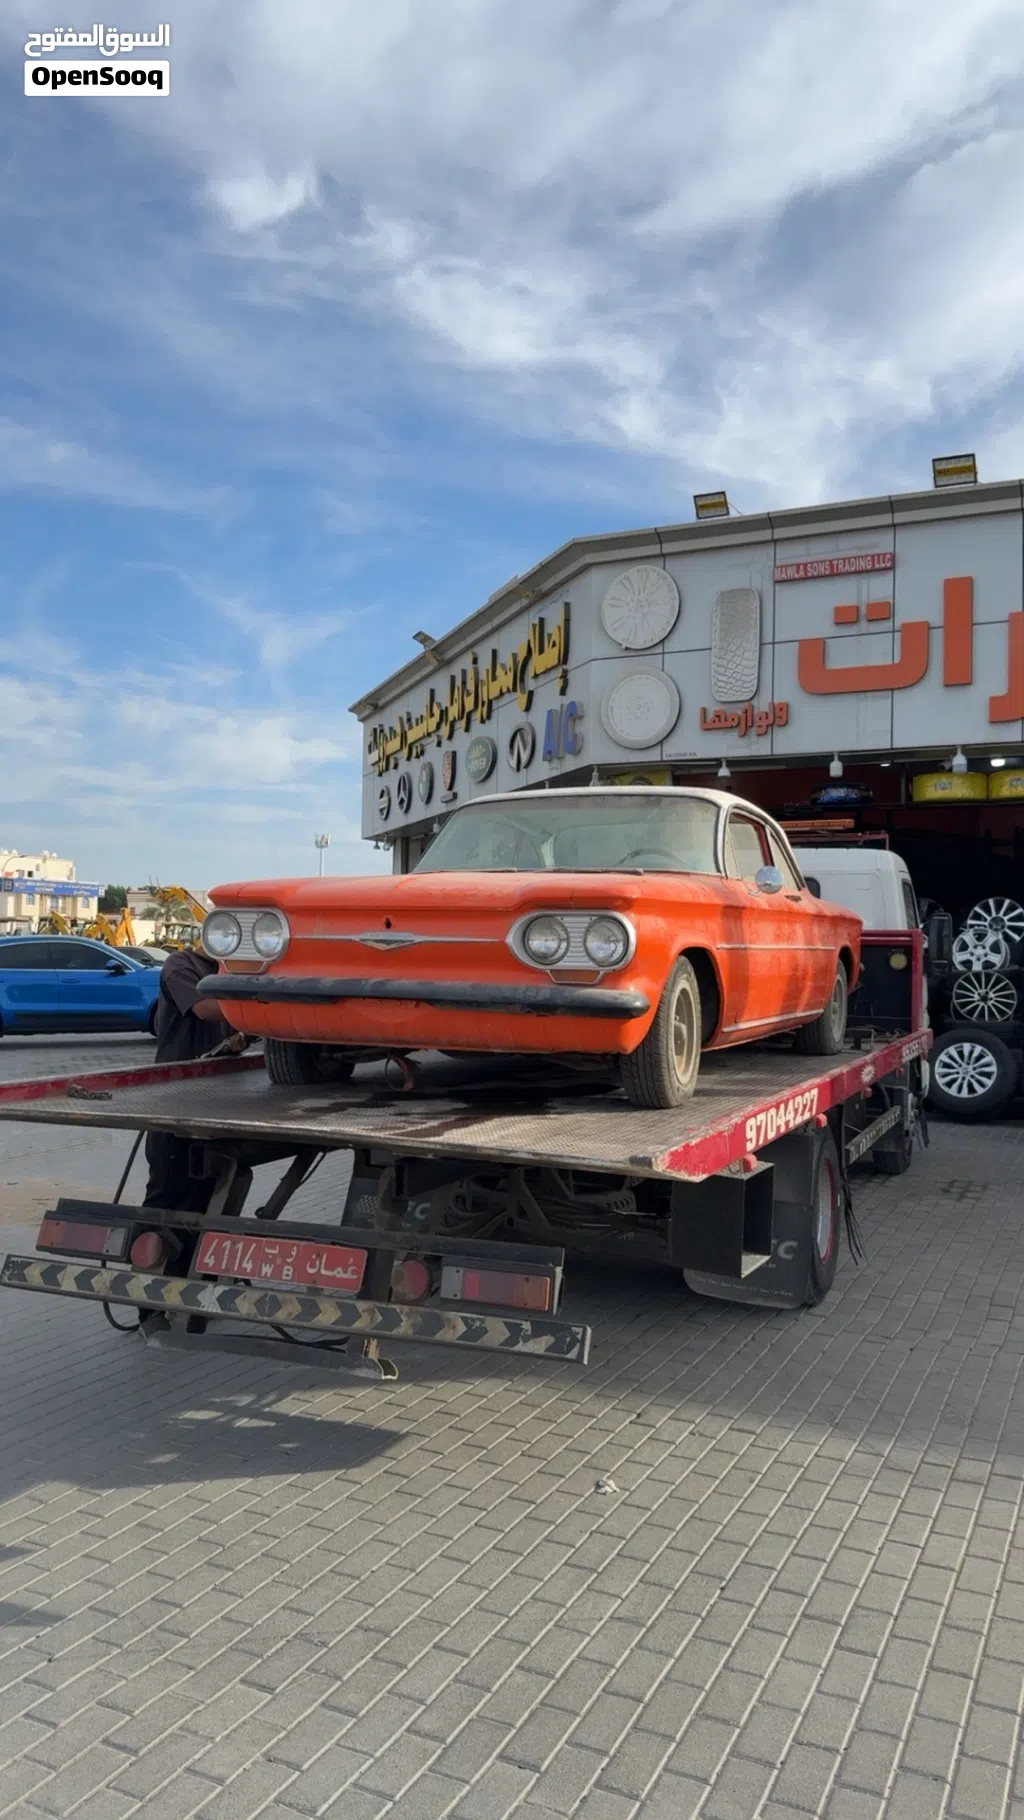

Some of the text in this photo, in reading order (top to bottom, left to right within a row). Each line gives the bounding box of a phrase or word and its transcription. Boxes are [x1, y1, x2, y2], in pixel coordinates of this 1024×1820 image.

[774, 553, 893, 581] MAWLA SONS TRADING LLC
[516, 601, 570, 712] إصلاح
[700, 702, 788, 737] ولوازمها
[745, 1087, 818, 1152] 97044227
[203, 1238, 256, 1272] 4114
